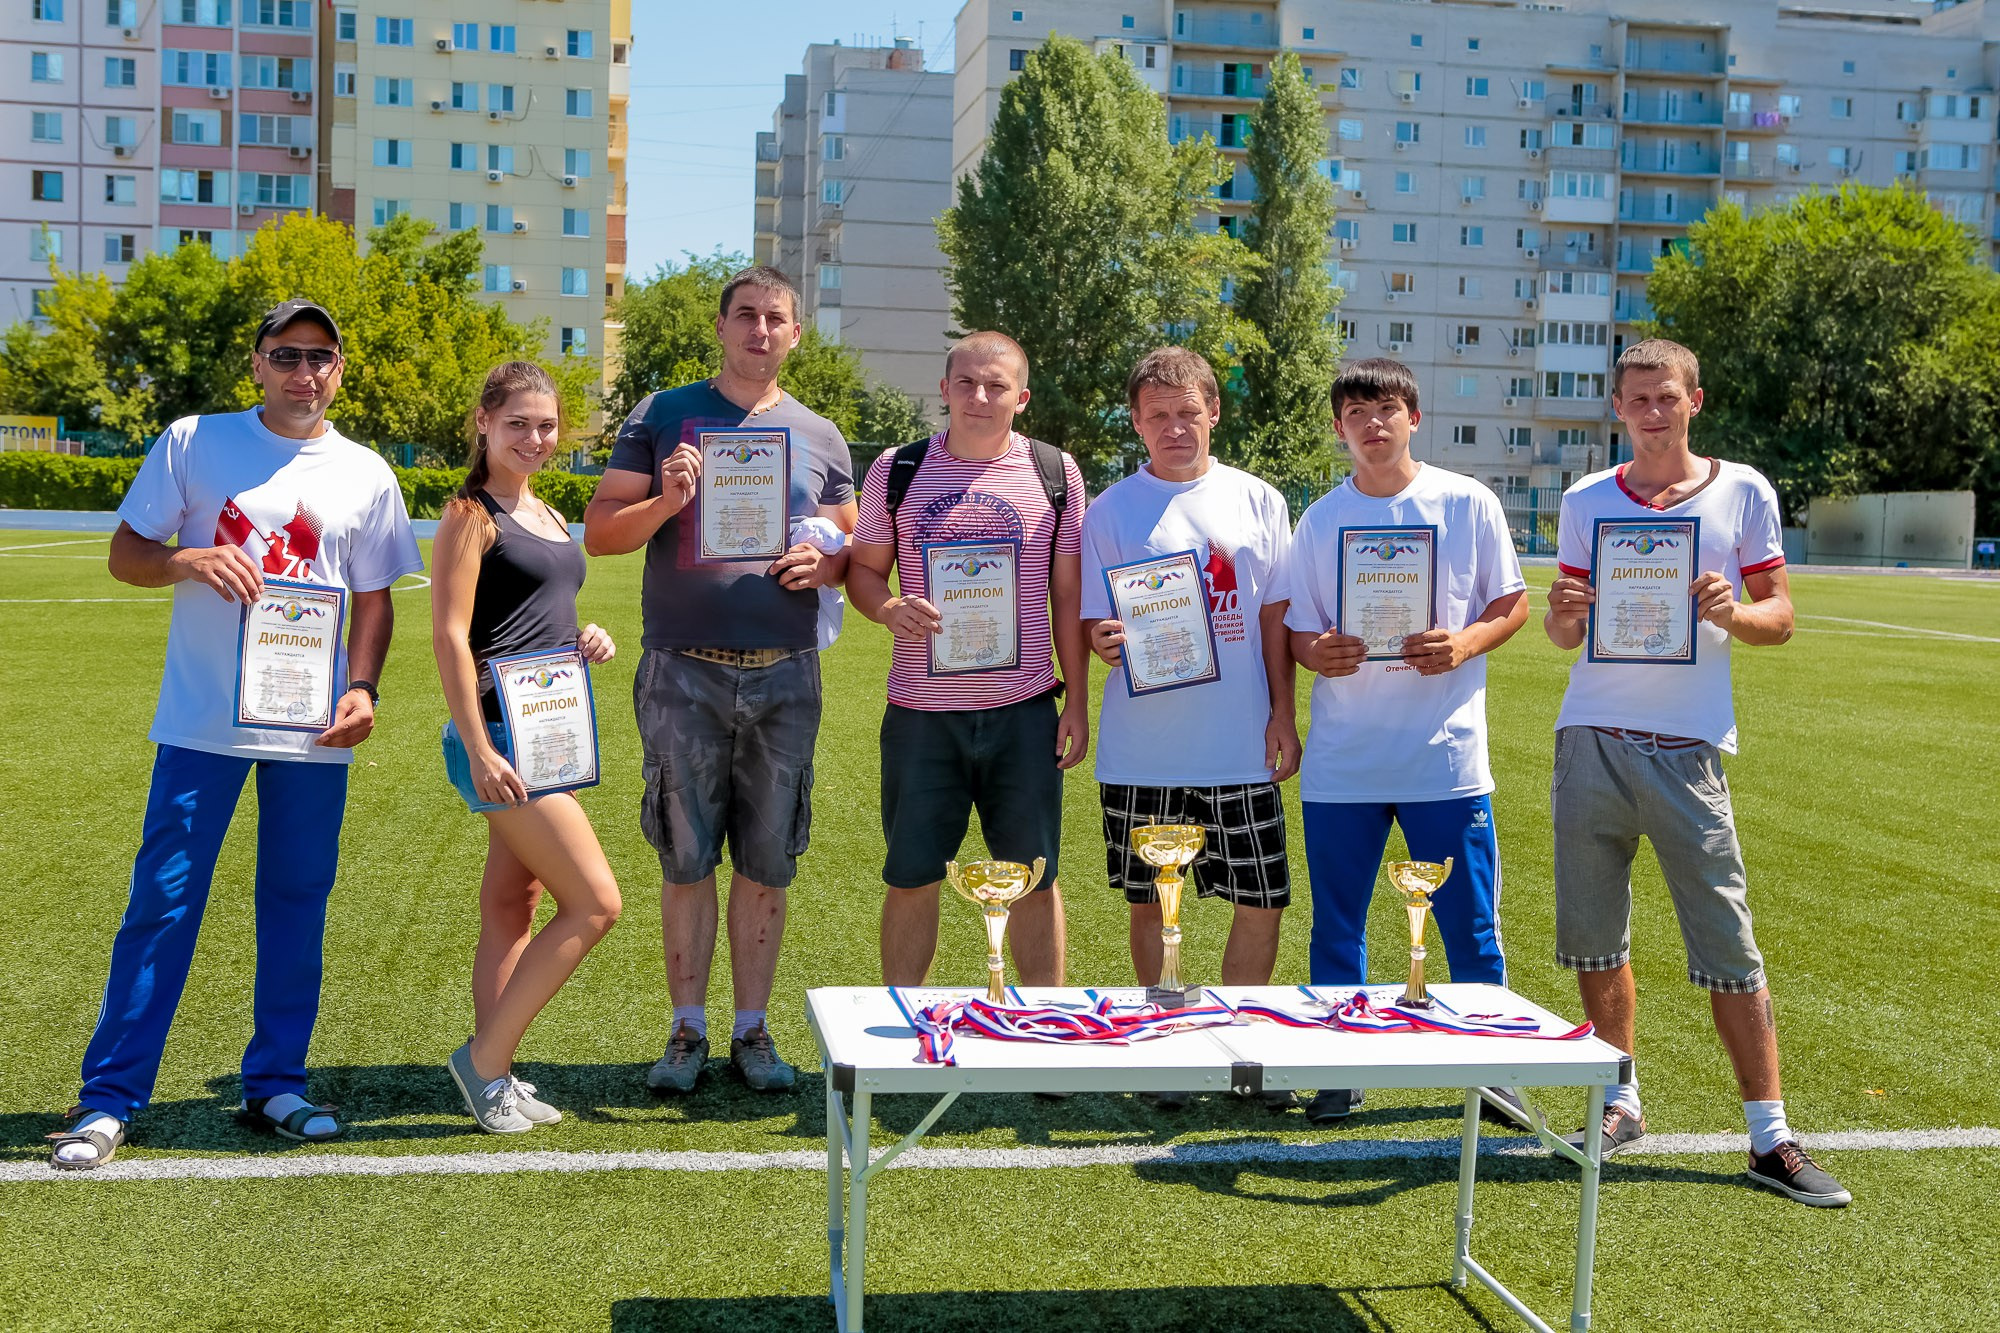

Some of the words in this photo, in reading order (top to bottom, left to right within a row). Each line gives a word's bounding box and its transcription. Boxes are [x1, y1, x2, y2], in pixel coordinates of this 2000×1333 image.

[713, 475, 774, 488] ДИПЛОМ
[980, 495, 1001, 509] THE
[1356, 572, 1419, 585] ДИПЛОМ
[1611, 567, 1678, 581] ДИПЛОМ
[943, 587, 1004, 602] ДИПЛОМ
[1211, 590, 1241, 613] 70
[1131, 596, 1192, 619] ДИПЛОМ
[1212, 613, 1243, 622] ПОБЕДЫ
[1214, 621, 1244, 630] Великой
[258, 632, 322, 649] ДИПЛОМ
[1224, 635, 1245, 643] войне
[521, 696, 578, 717] ДИПЛОМ
